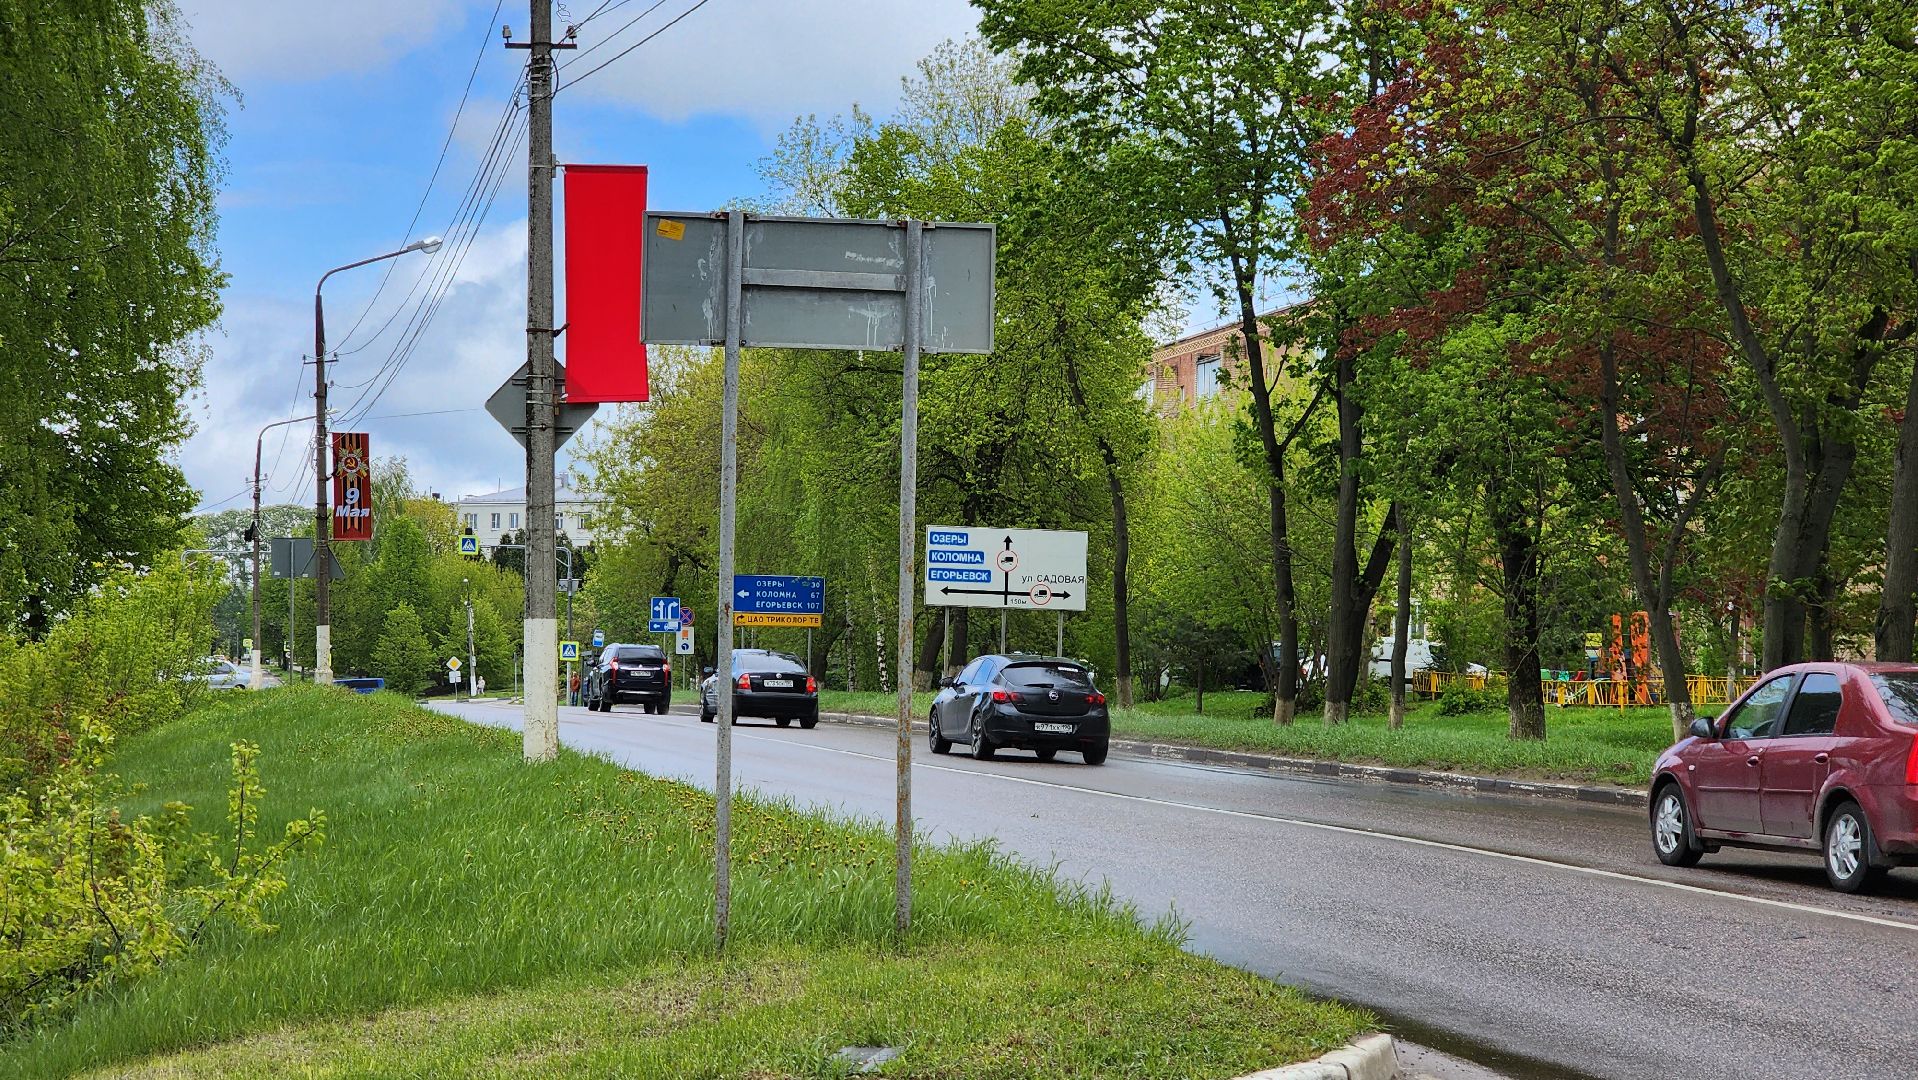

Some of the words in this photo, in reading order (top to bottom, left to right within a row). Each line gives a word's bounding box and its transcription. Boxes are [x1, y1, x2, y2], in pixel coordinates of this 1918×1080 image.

[345, 487, 360, 504] 9
[335, 505, 370, 517] Мая
[932, 534, 967, 544] ОЗЕРЫ
[931, 551, 982, 562] КОЛОМНА
[930, 570, 989, 581] ЕГОРЬЕВСК
[1037, 574, 1085, 584] САДОВАЯ
[811, 581, 820, 589] 30
[756, 590, 797, 598] КОЛОМНА
[755, 601, 803, 609] ЕГОРЬЕВСК
